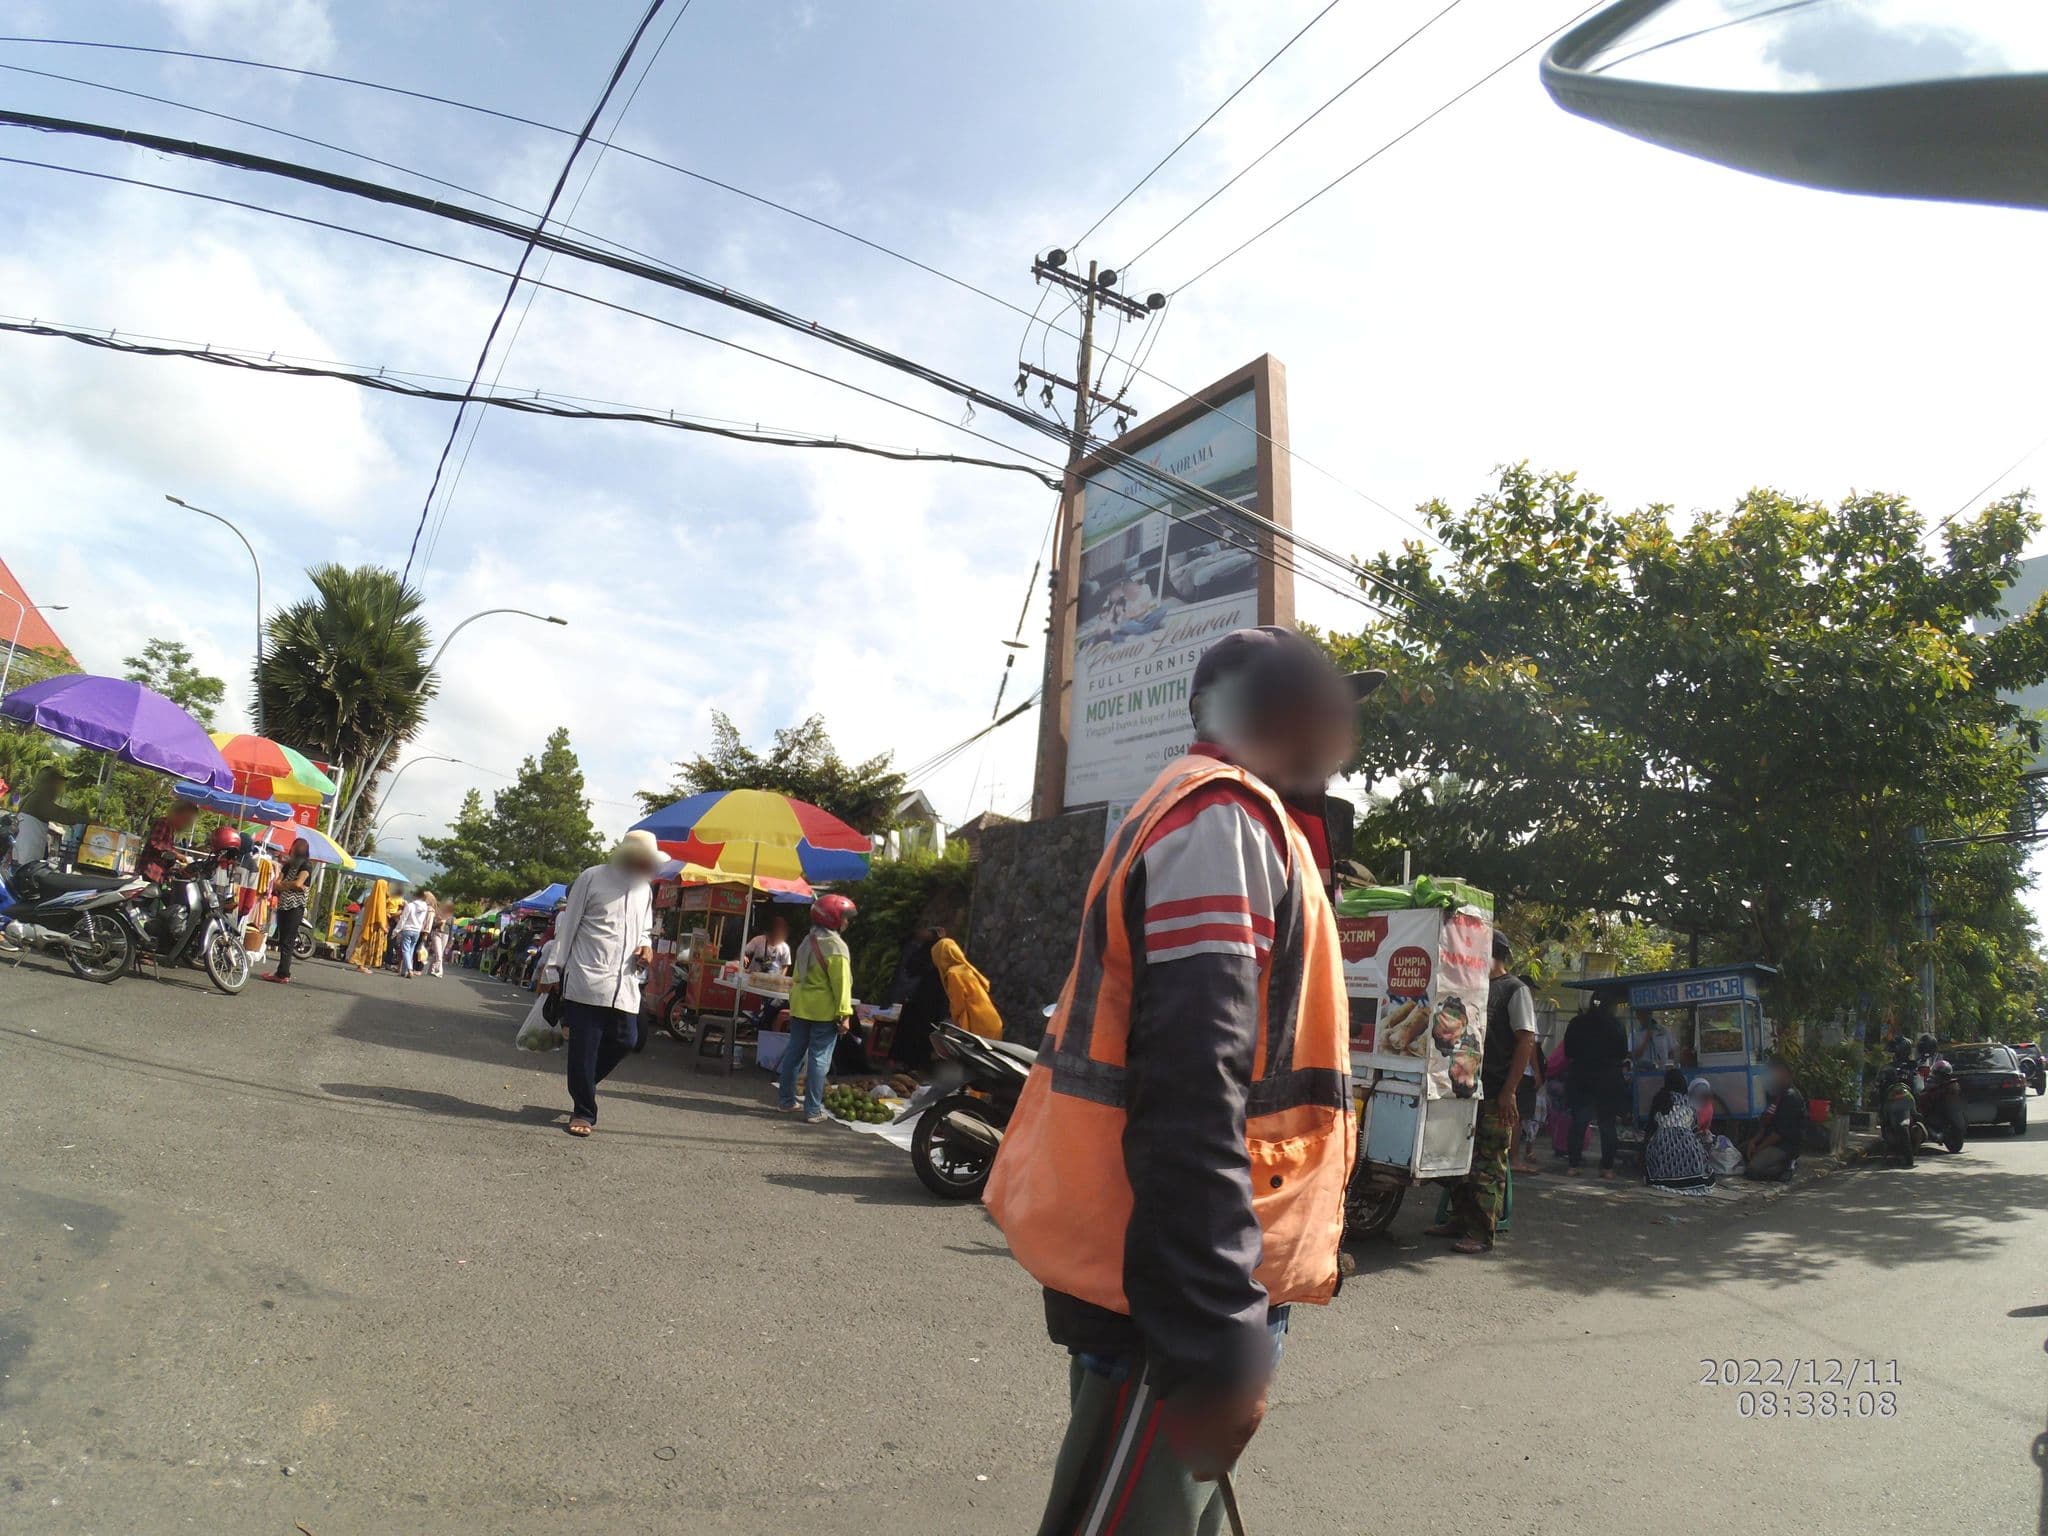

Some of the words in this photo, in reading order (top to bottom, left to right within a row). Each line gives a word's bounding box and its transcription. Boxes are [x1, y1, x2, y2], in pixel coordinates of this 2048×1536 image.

[1152, 609, 1241, 654] Lebaran
[1089, 674, 1123, 692] FULL
[1134, 647, 1207, 679] FURNIS
[1086, 694, 1124, 724] MOVE
[1128, 690, 1143, 713] IN
[1146, 677, 1188, 708] WITH
[1393, 955, 1427, 968] LUMPIA
[1390, 976, 1427, 989] GULUNG
[1396, 967, 1421, 978] TAHU
[1684, 978, 1740, 999] REMAJA
